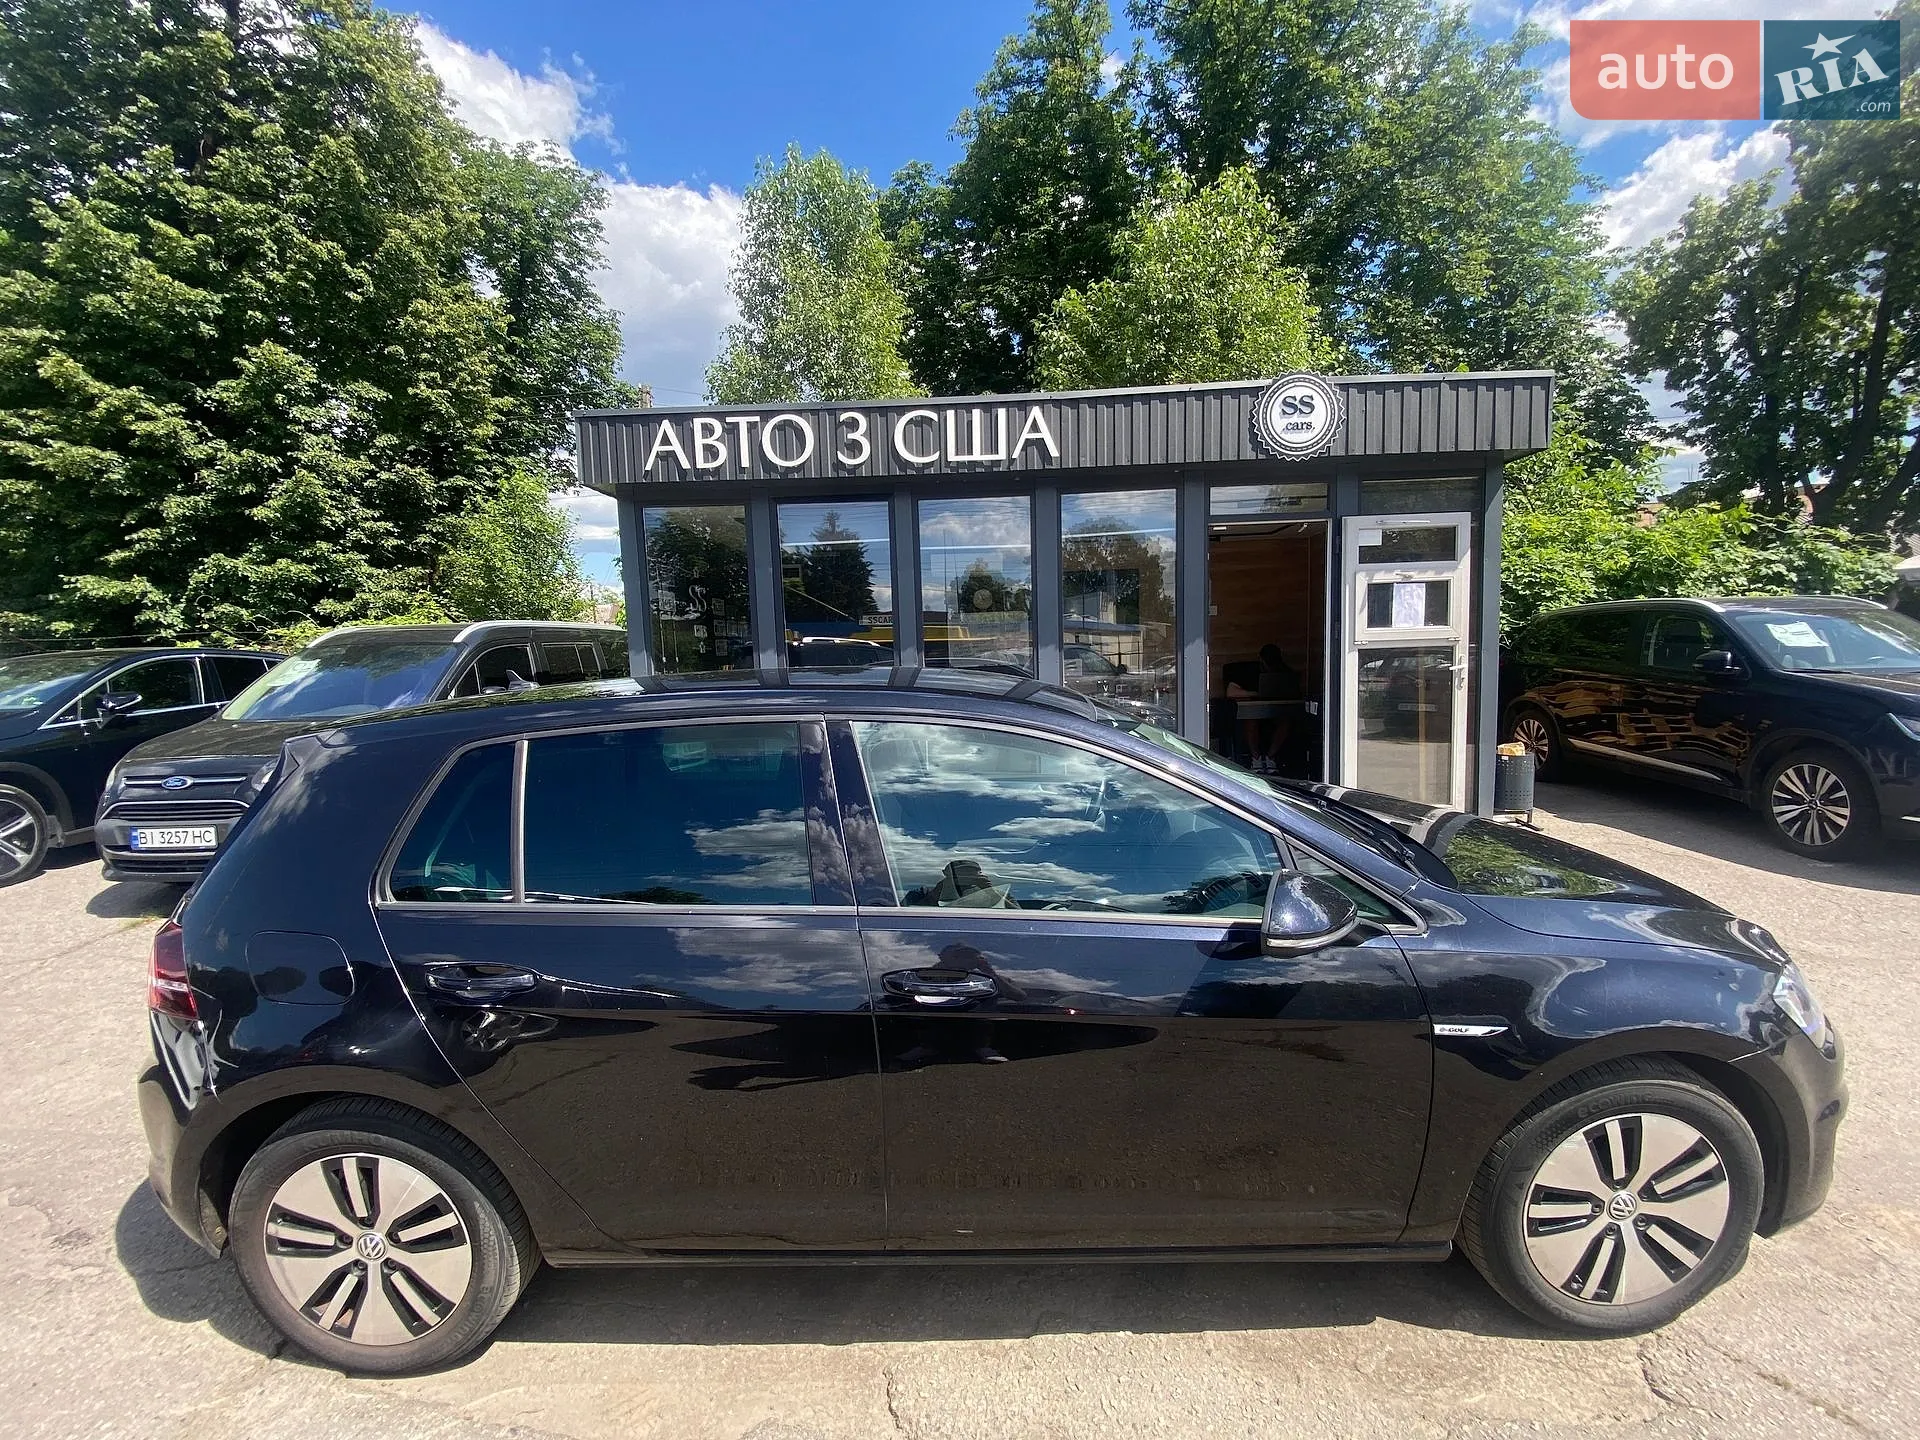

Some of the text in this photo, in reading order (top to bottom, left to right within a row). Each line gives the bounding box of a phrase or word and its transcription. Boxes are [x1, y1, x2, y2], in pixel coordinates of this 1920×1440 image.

[1282, 395, 1315, 415] SS
[644, 413, 813, 471] АВТО
[892, 406, 1060, 464] США
[139, 829, 213, 844] BI 3257 HC
